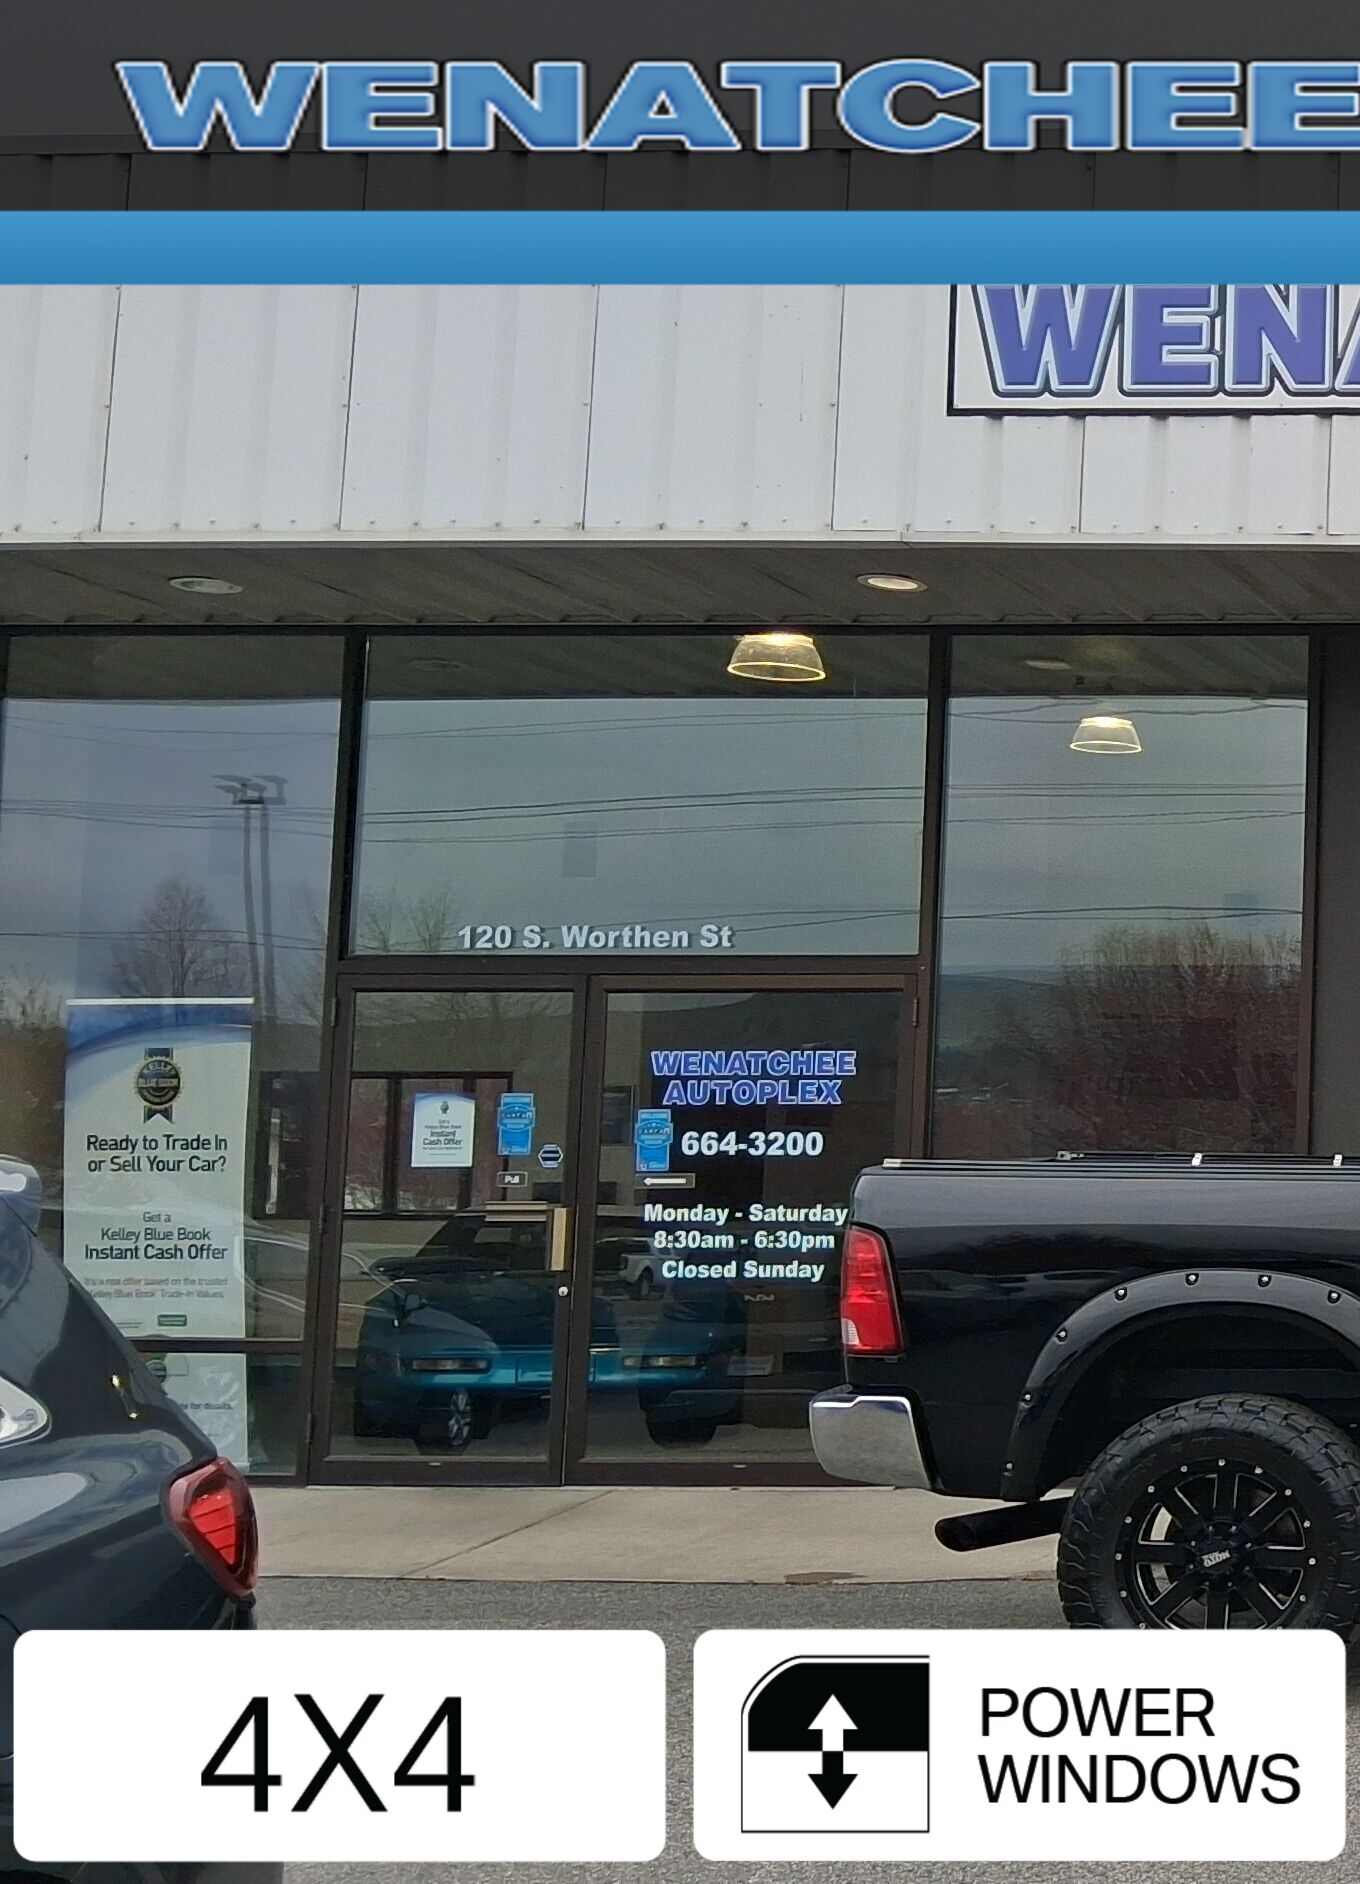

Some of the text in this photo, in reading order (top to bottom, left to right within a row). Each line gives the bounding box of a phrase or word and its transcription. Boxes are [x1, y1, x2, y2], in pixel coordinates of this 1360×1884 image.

[459, 924, 734, 948] 120 S. Worthen St
[650, 1050, 857, 1076] WENATCHEE
[662, 1080, 842, 1106] AUTOPLEX
[87, 1134, 228, 1154] Ready to Trade In
[682, 1131, 824, 1156] 664-3200
[88, 1155, 227, 1172] or Sell Your Car?
[143, 1211, 171, 1223] Get a
[644, 1204, 730, 1226] Monday
[748, 1203, 849, 1226] Saturday
[101, 1227, 211, 1244] Kelley Blue Book
[653, 1230, 734, 1249] 8:30am
[754, 1230, 835, 1253] 6:30pm
[85, 1244, 228, 1260] Instant Cash Offer
[661, 1260, 825, 1283] Closed Sunday
